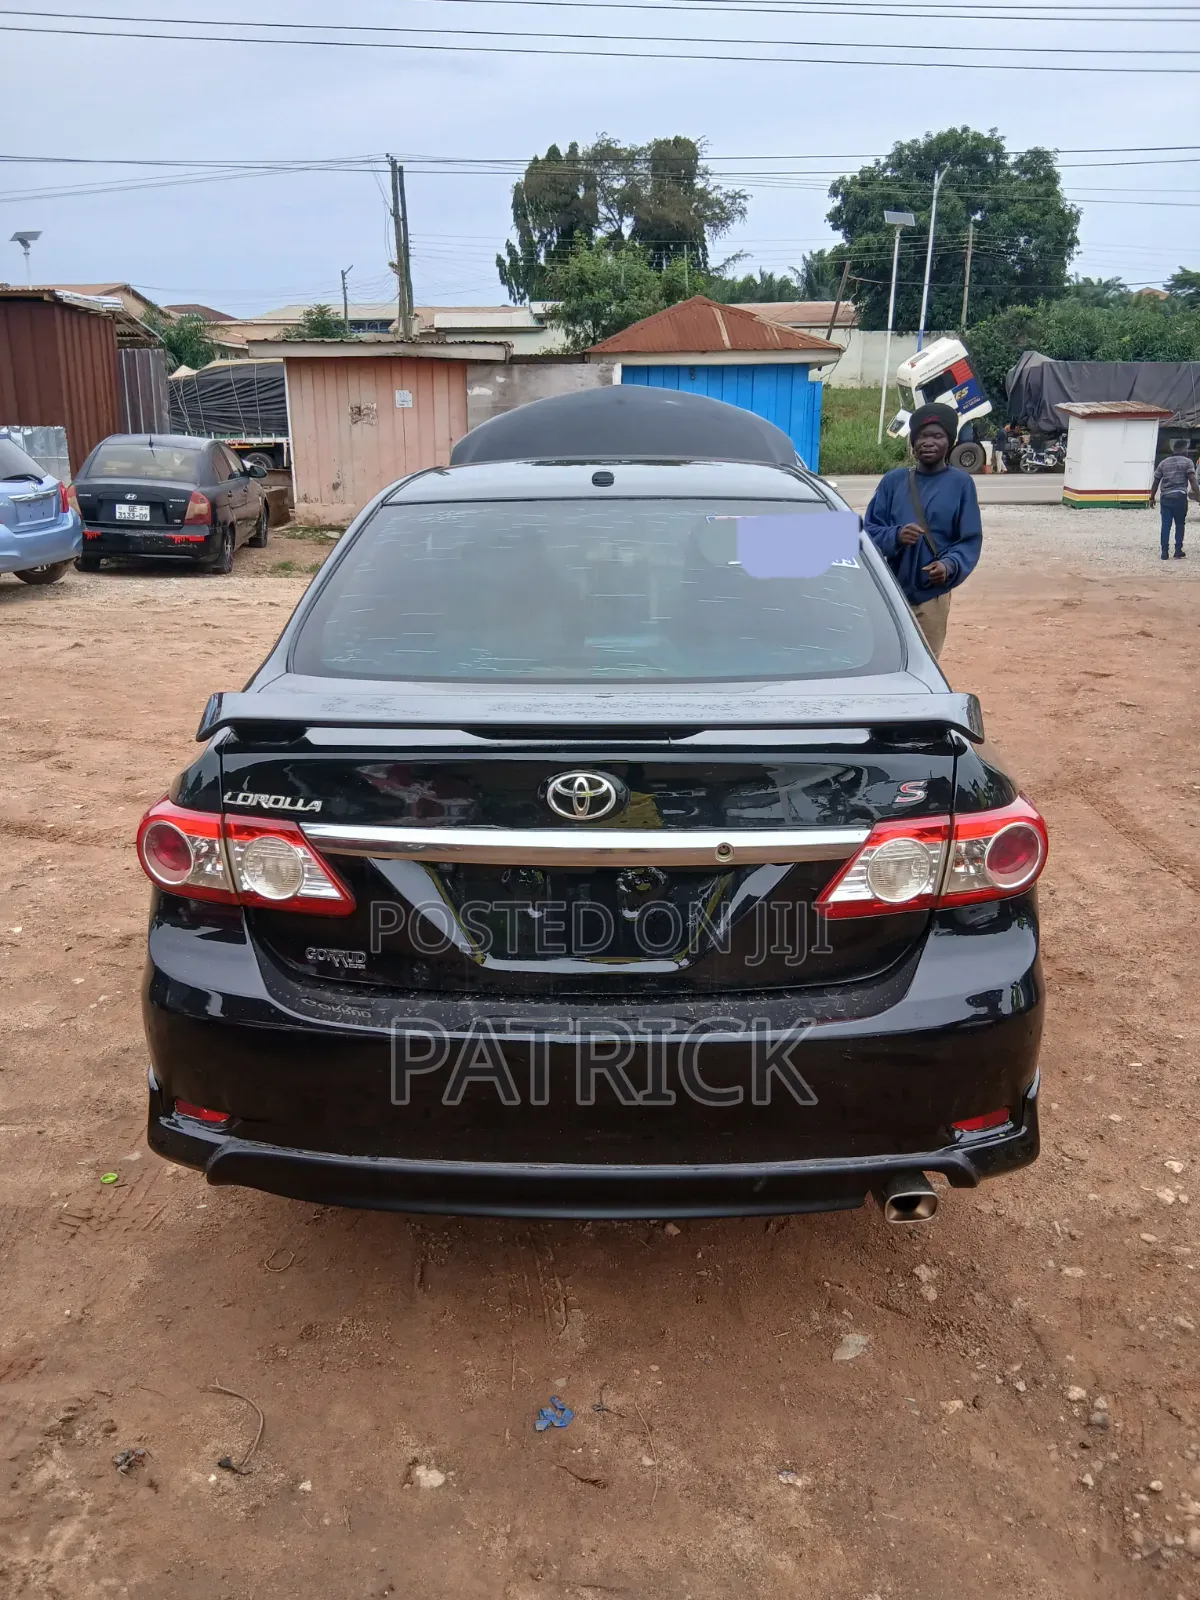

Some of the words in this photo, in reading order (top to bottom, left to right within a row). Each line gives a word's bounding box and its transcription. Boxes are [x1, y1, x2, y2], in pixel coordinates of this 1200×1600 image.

[128, 505, 138, 513] GE
[117, 512, 149, 520] 3133-09
[892, 780, 928, 808] S
